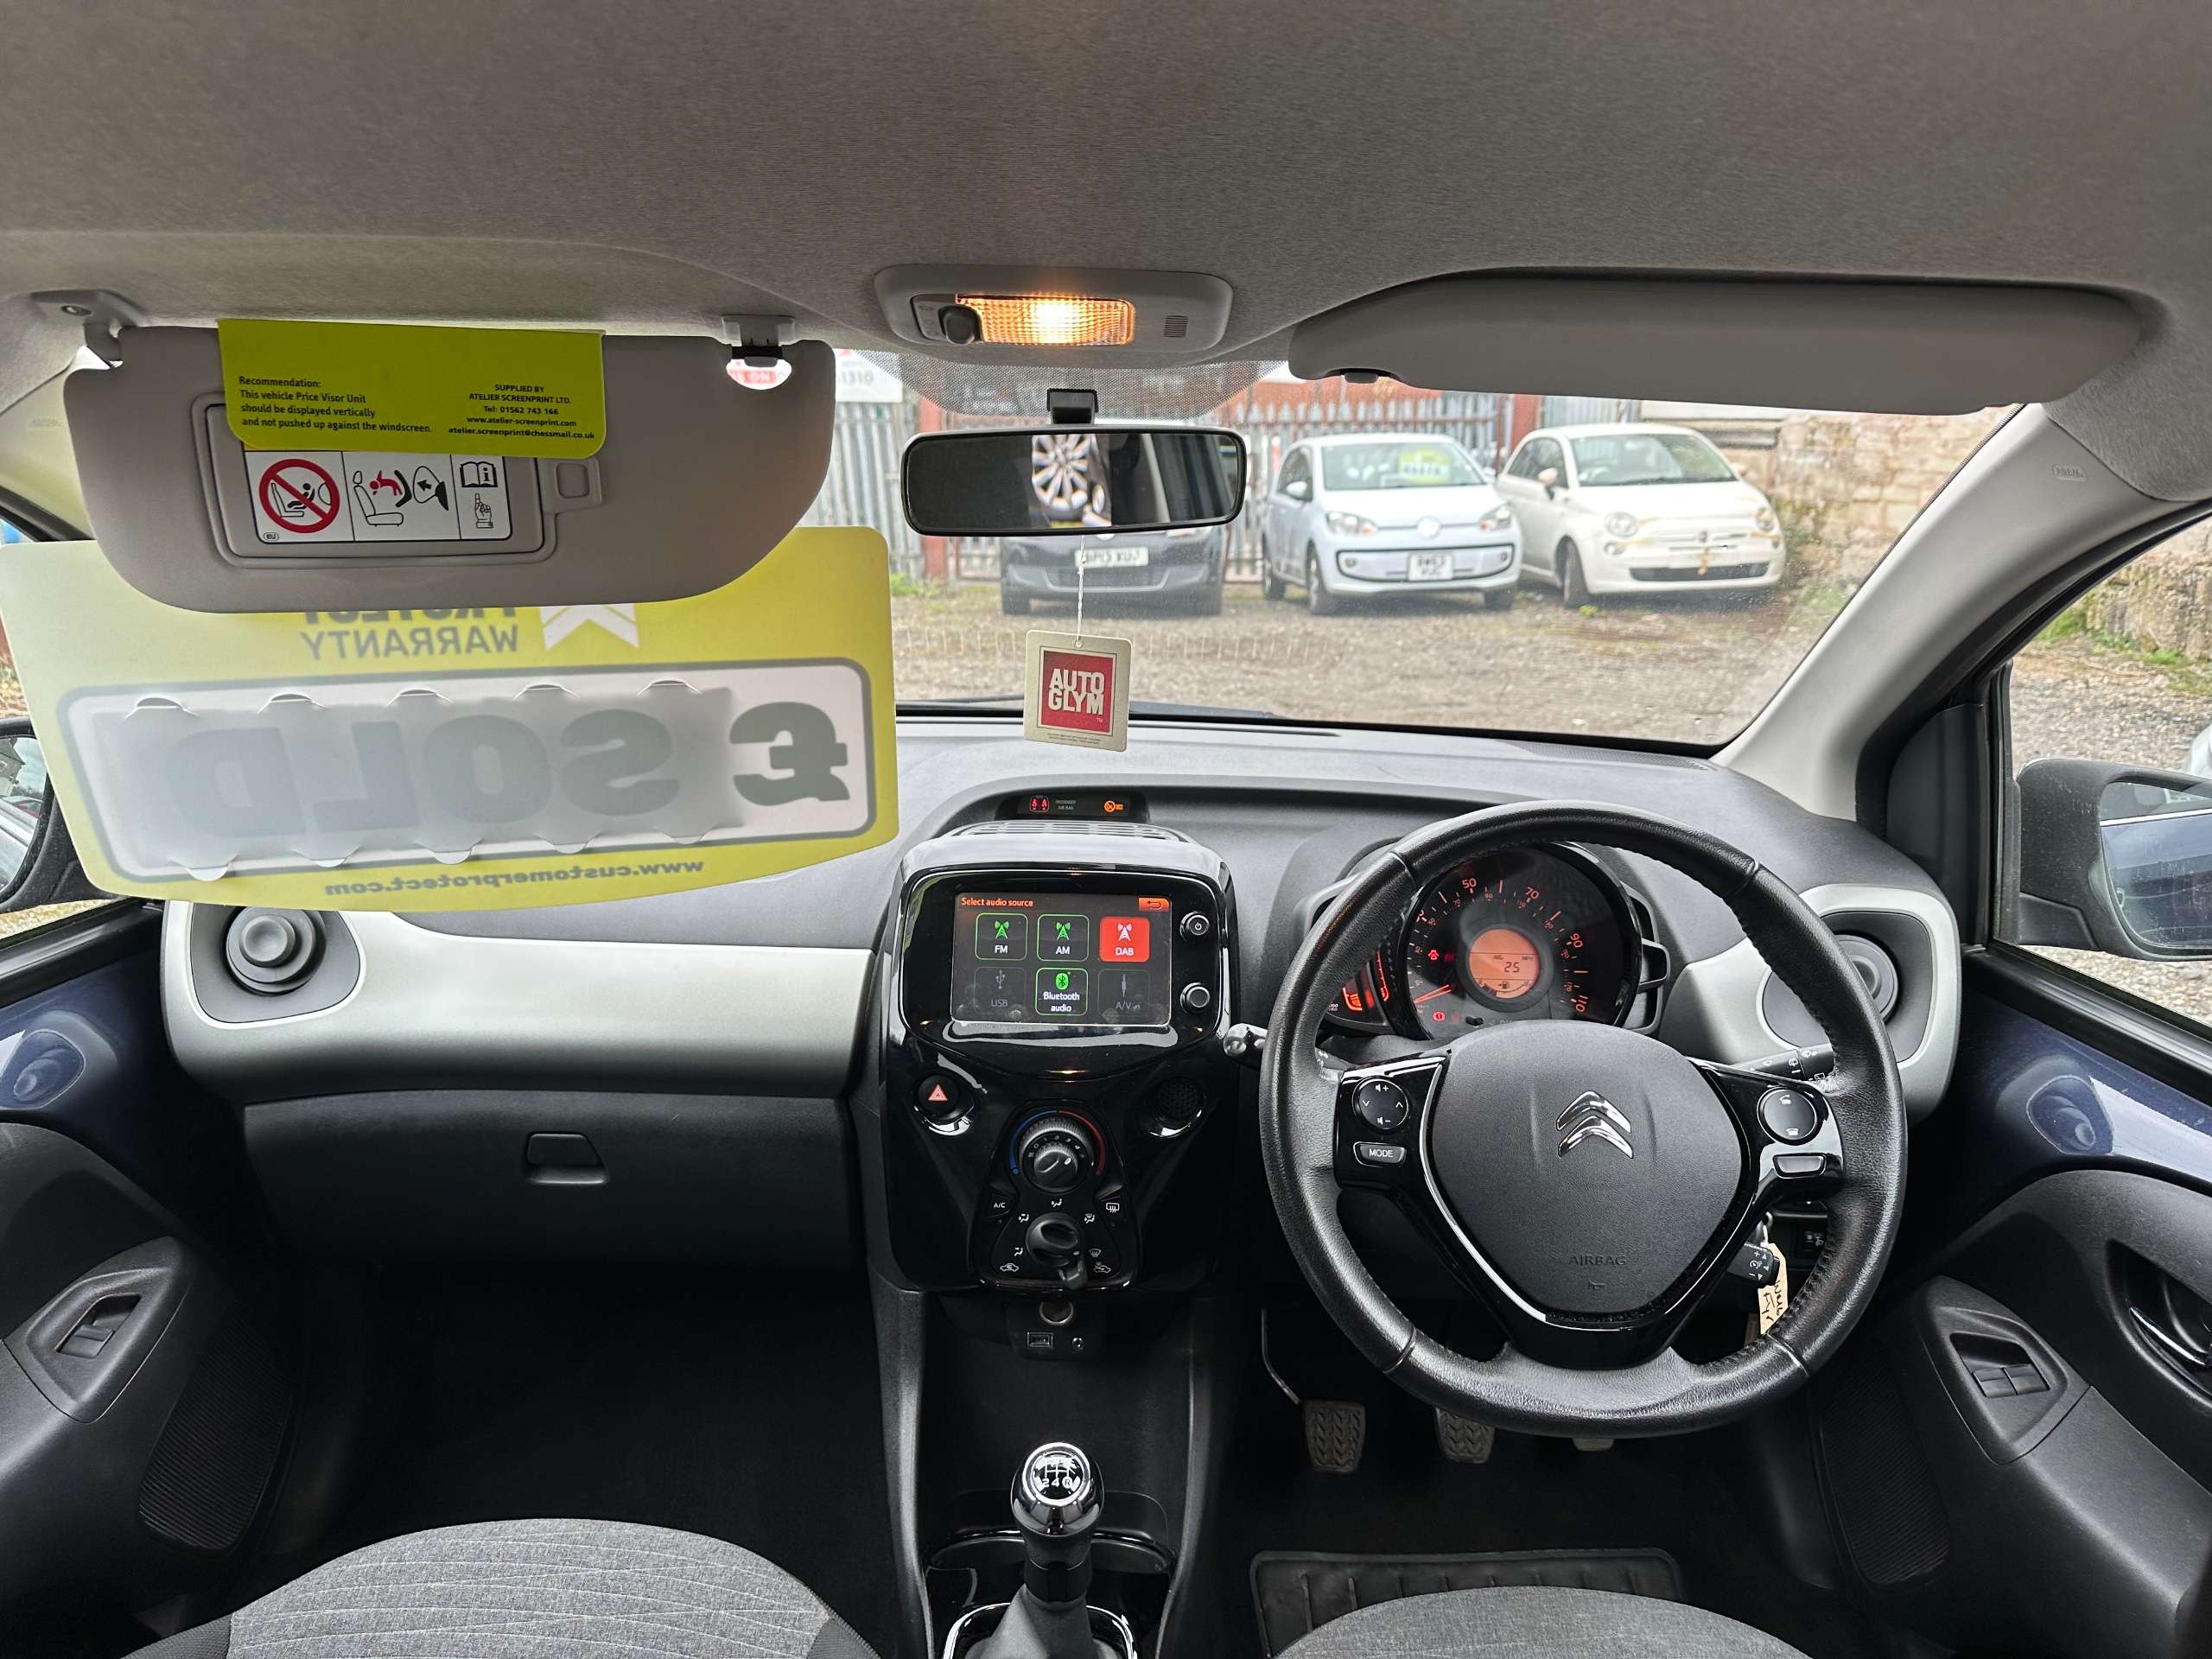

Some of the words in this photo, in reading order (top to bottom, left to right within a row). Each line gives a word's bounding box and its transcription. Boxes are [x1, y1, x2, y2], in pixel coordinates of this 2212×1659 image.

[238, 376, 321, 387] Recommendation:
[494, 384, 533, 393] SUPPLIED
[239, 390, 259, 399] This
[262, 391, 294, 400] vehicle
[296, 392, 319, 401] Price
[321, 393, 345, 402] Visor
[346, 394, 366, 404] Unit
[502, 394, 554, 404] SCREENPRINT
[242, 404, 271, 413] should
[274, 404, 285, 414] be
[288, 405, 331, 416] displayed
[334, 408, 375, 418] vertically
[262, 419, 276, 428] not
[279, 419, 312, 429] pushed
[314, 422, 325, 430] up
[327, 420, 360, 431] against
[362, 421, 377, 430] the
[466, 416, 577, 428] www.atelier-screenprint.com
[1049, 668, 1105, 694] AUTO
[1048, 689, 1104, 715] GLYM
[1462, 878, 1477, 888] 50
[1525, 887, 1539, 899] 70
[961, 897, 985, 906] Select
[985, 898, 1007, 906] audio
[1570, 933, 1583, 948] 90
[1055, 946, 1071, 955] AM
[1115, 947, 1134, 956] DAB
[1504, 962, 1520, 973] 25
[1043, 992, 1080, 1001] Bluetooth
[991, 999, 1008, 1007] USB
[1051, 1004, 1072, 1013] audio
[1575, 995, 1589, 1013] 110
[1369, 1148, 1393, 1158] MODE
[1570, 1253, 1627, 1266] AIRBAG
[1042, 1478, 1050, 1488] 2
[1051, 1478, 1059, 1487] 4
